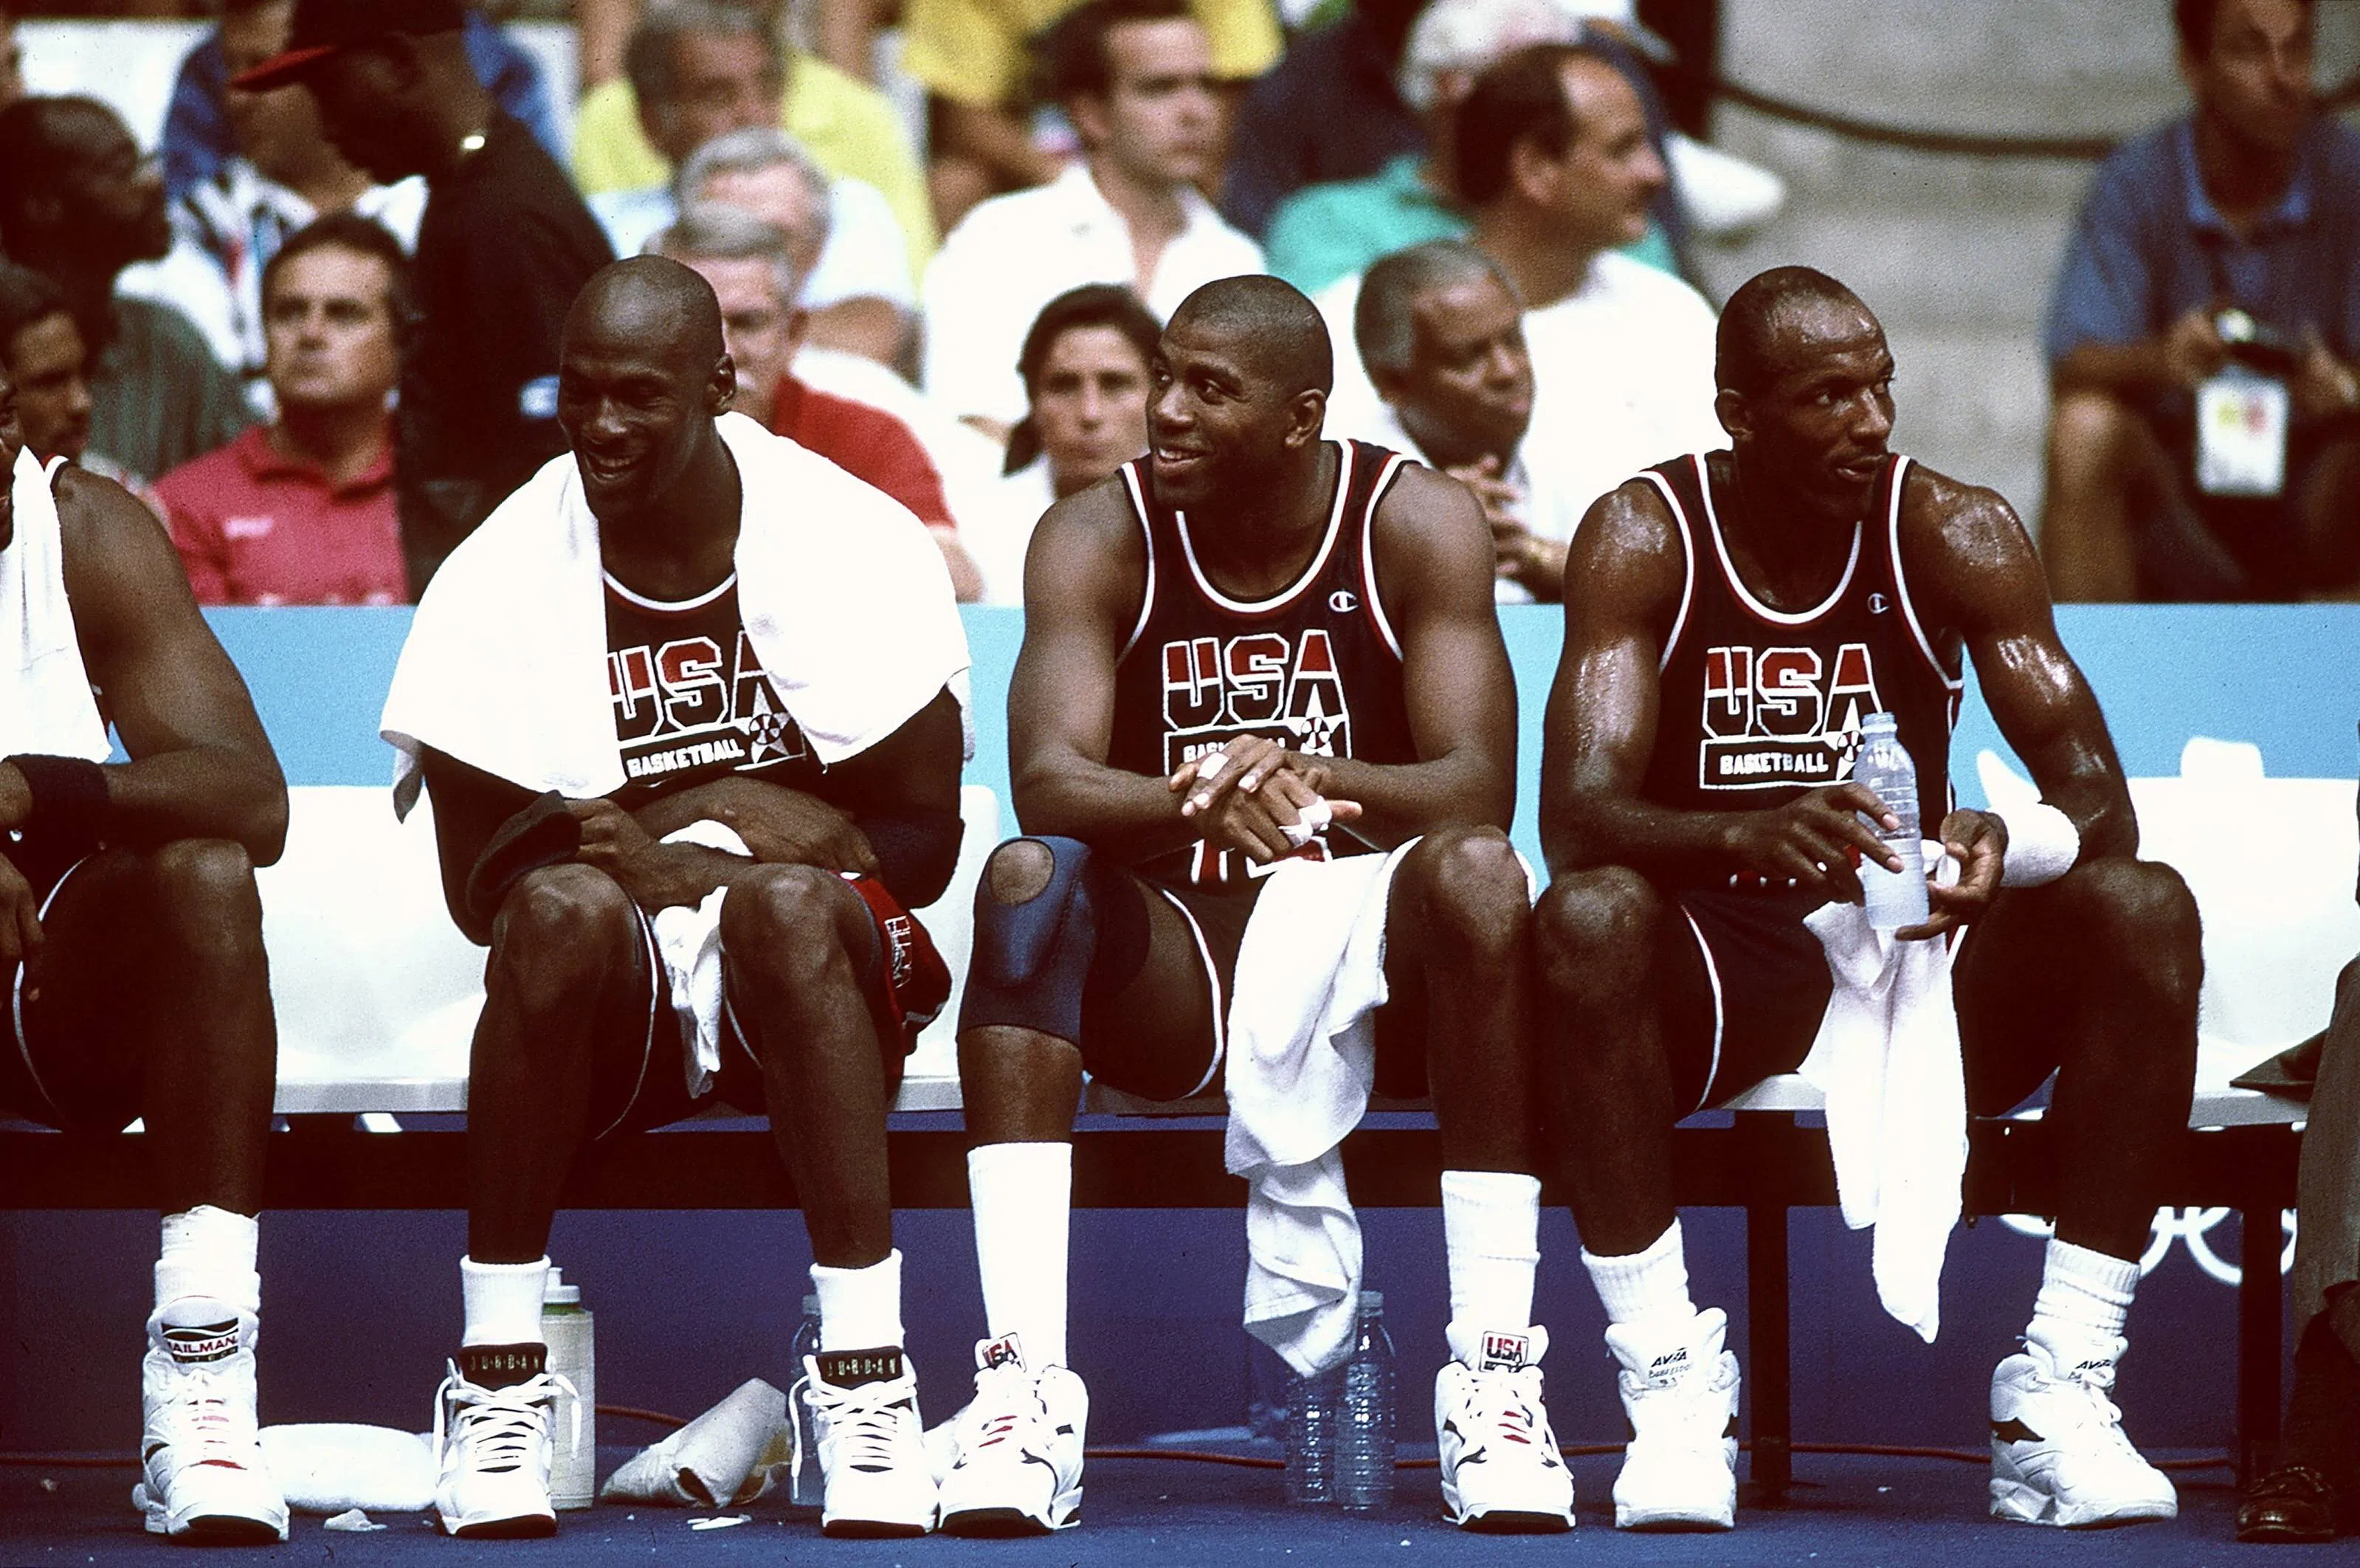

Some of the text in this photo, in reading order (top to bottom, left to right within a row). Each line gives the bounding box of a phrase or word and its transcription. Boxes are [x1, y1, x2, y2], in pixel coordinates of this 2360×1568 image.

[1163, 629, 1350, 731] USA
[1701, 643, 1883, 739] USA
[627, 739, 745, 778] BASKETBALL
[1719, 752, 1829, 775] BASKETBALL
[1486, 1336, 1522, 1362] USA
[1651, 1347, 1687, 1367] AVIA
